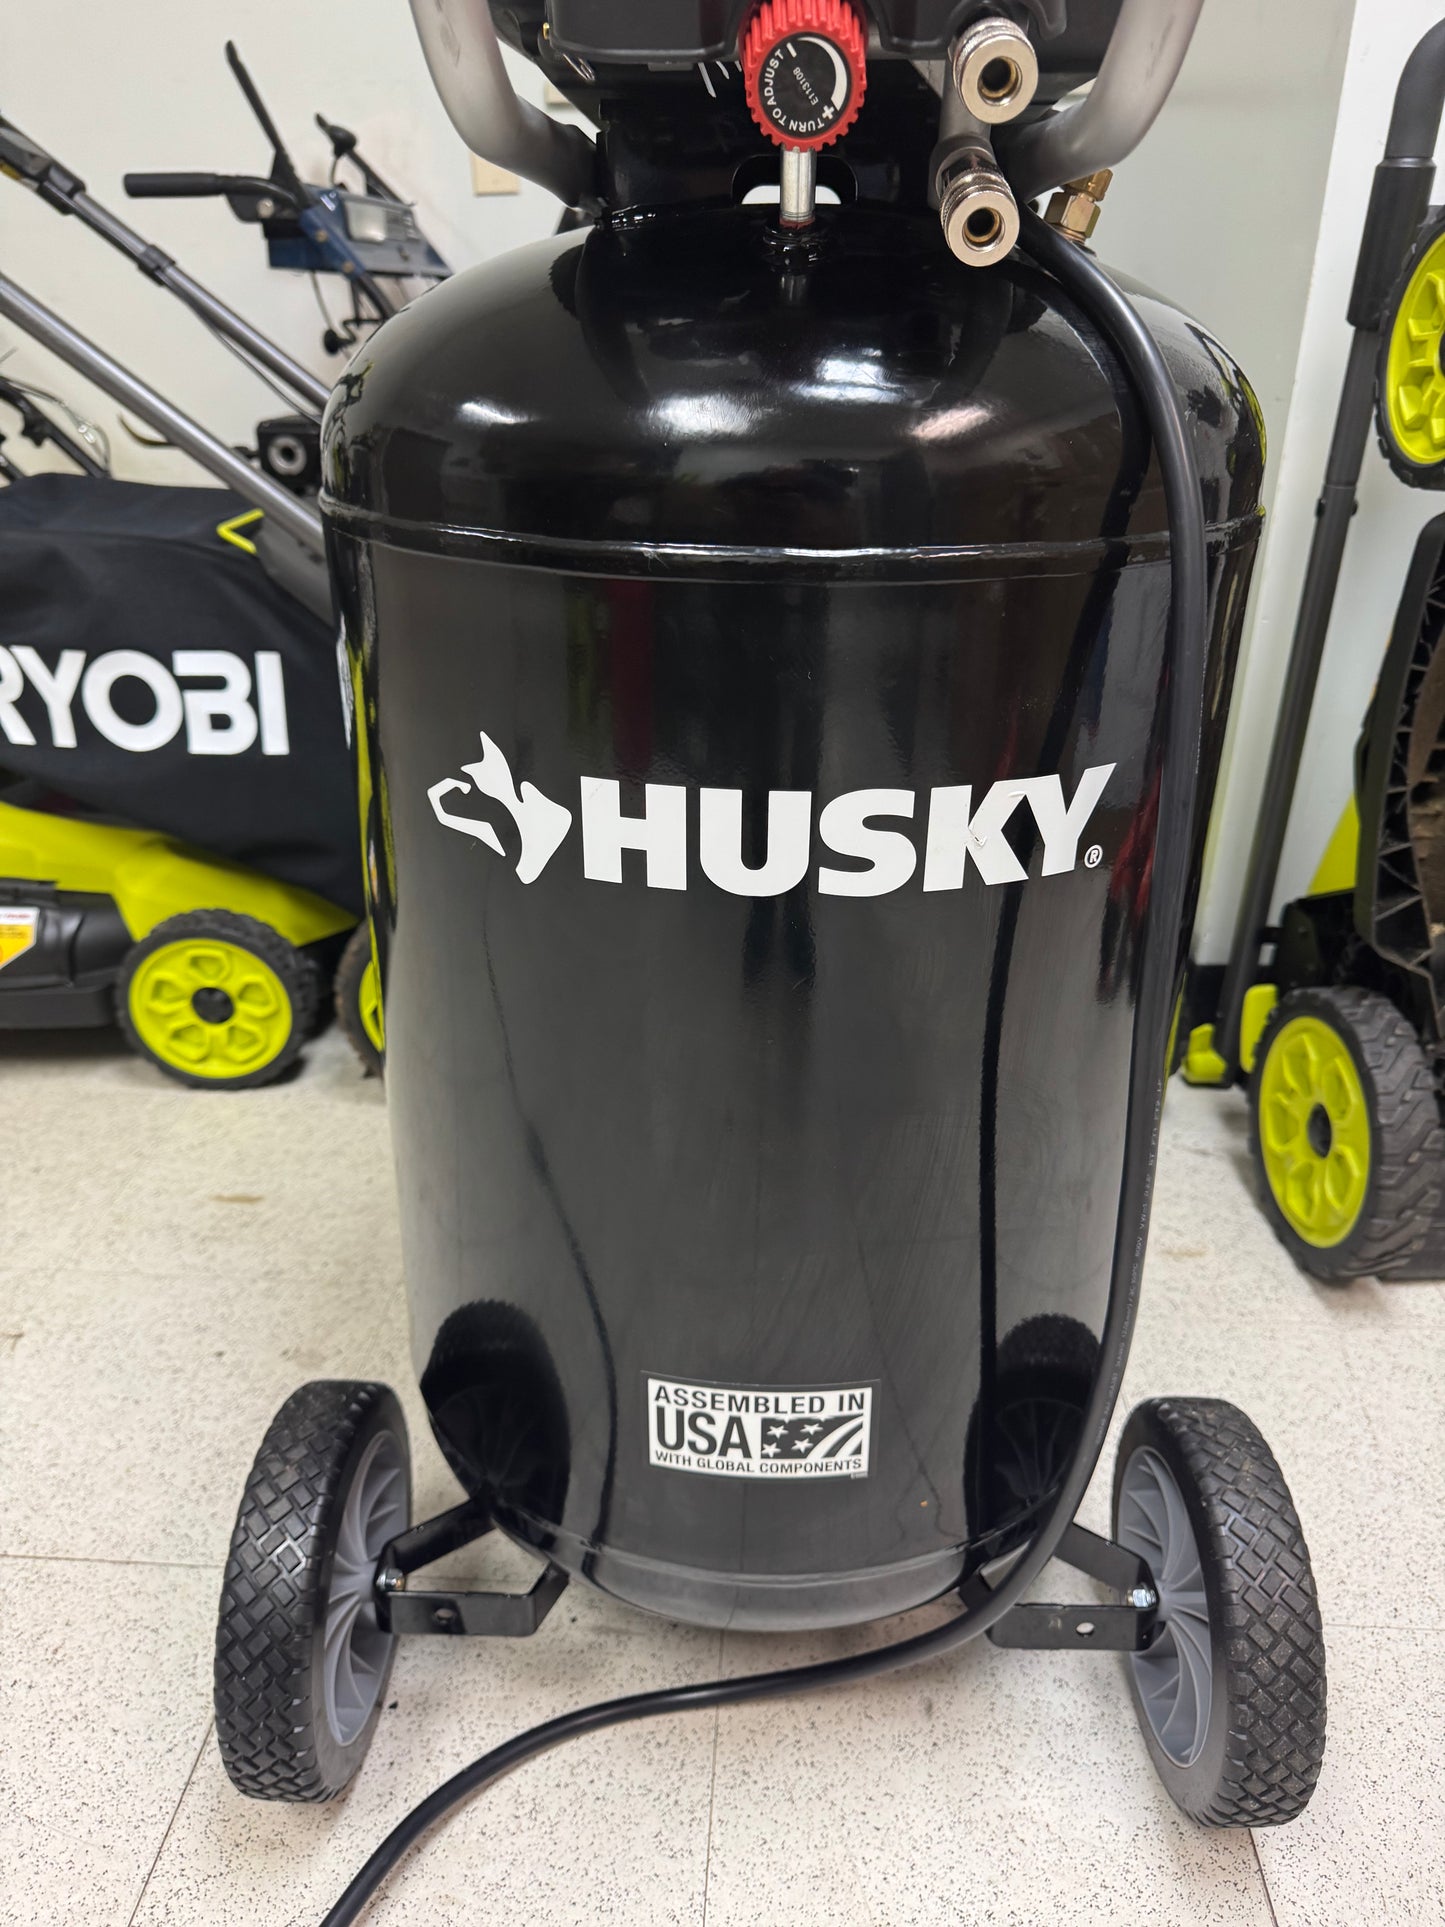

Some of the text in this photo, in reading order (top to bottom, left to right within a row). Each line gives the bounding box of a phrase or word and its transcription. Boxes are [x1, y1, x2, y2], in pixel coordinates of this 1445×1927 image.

[764, 48, 825, 133] TURN TO ADJUST
[580, 762, 1117, 897] HUSKY
[654, 1385, 865, 1415] ASSEMBLED IN
[656, 1405, 753, 1460] USA
[655, 1450, 863, 1474] WITH GLOBAL COMPONENTS
